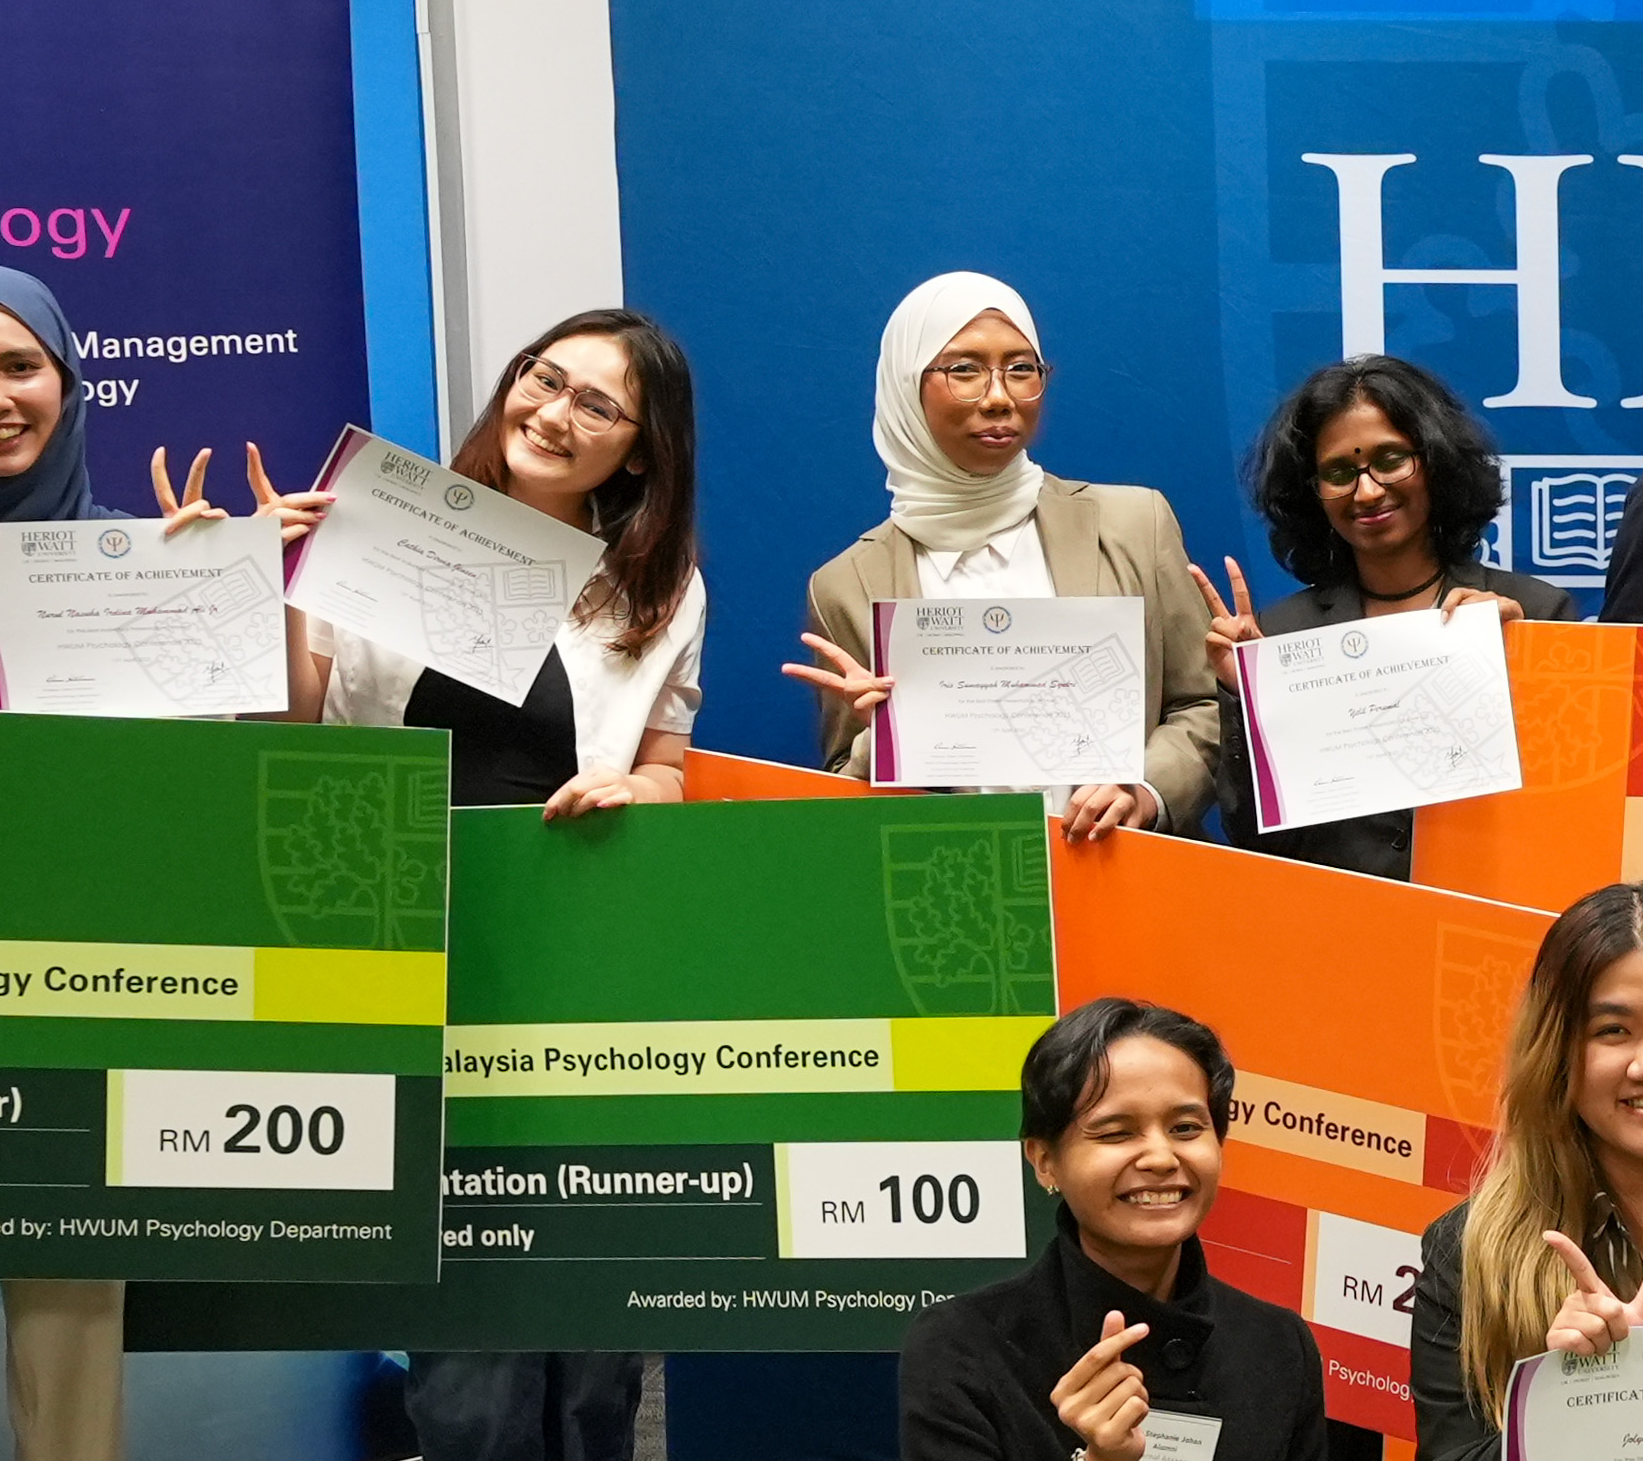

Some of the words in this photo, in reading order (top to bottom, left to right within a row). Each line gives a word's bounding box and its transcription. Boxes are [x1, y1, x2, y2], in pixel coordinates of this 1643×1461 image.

[70, 327, 298, 367] Management
[21, 530, 76, 543] HERIOT
[371, 488, 444, 527] CERTIFICATE
[443, 520, 459, 532] OF
[459, 529, 536, 567] ACHIEVEMENT
[37, 540, 77, 553] WATT
[28, 571, 113, 585] CERTIFICATE
[115, 571, 132, 581] OF
[135, 568, 224, 581] ACHIEVEMENT
[922, 645, 995, 657] CERTIFICATE
[997, 645, 1012, 656] OF
[1014, 644, 1092, 656] ACHIEVEMENT
[1288, 671, 1357, 693] CERTIFICATE
[1358, 668, 1374, 680] OF
[1374, 655, 1451, 676] ACHIEVEMENT
[44, 965, 240, 997] Conference
[544, 1046, 707, 1079] Psychology
[716, 1044, 881, 1071] Conference
[159, 1128, 211, 1154] RM
[223, 1103, 346, 1156] 200
[1263, 1099, 1414, 1159] Conference
[556, 1161, 755, 1202] (Runner-up)
[821, 1201, 866, 1225] RM
[878, 1173, 981, 1226] 100
[21, 1217, 53, 1241] by:
[60, 1218, 139, 1237] HWUM
[146, 1219, 264, 1242] Psychology
[269, 1220, 394, 1242] Department
[480, 1224, 536, 1253] only
[627, 1290, 707, 1310] Awarded
[710, 1291, 738, 1313] by:
[743, 1291, 810, 1310] HWUM
[815, 1291, 917, 1313] Psychology
[1342, 1274, 1384, 1308] RM
[1328, 1358, 1415, 1405] Psycholog
